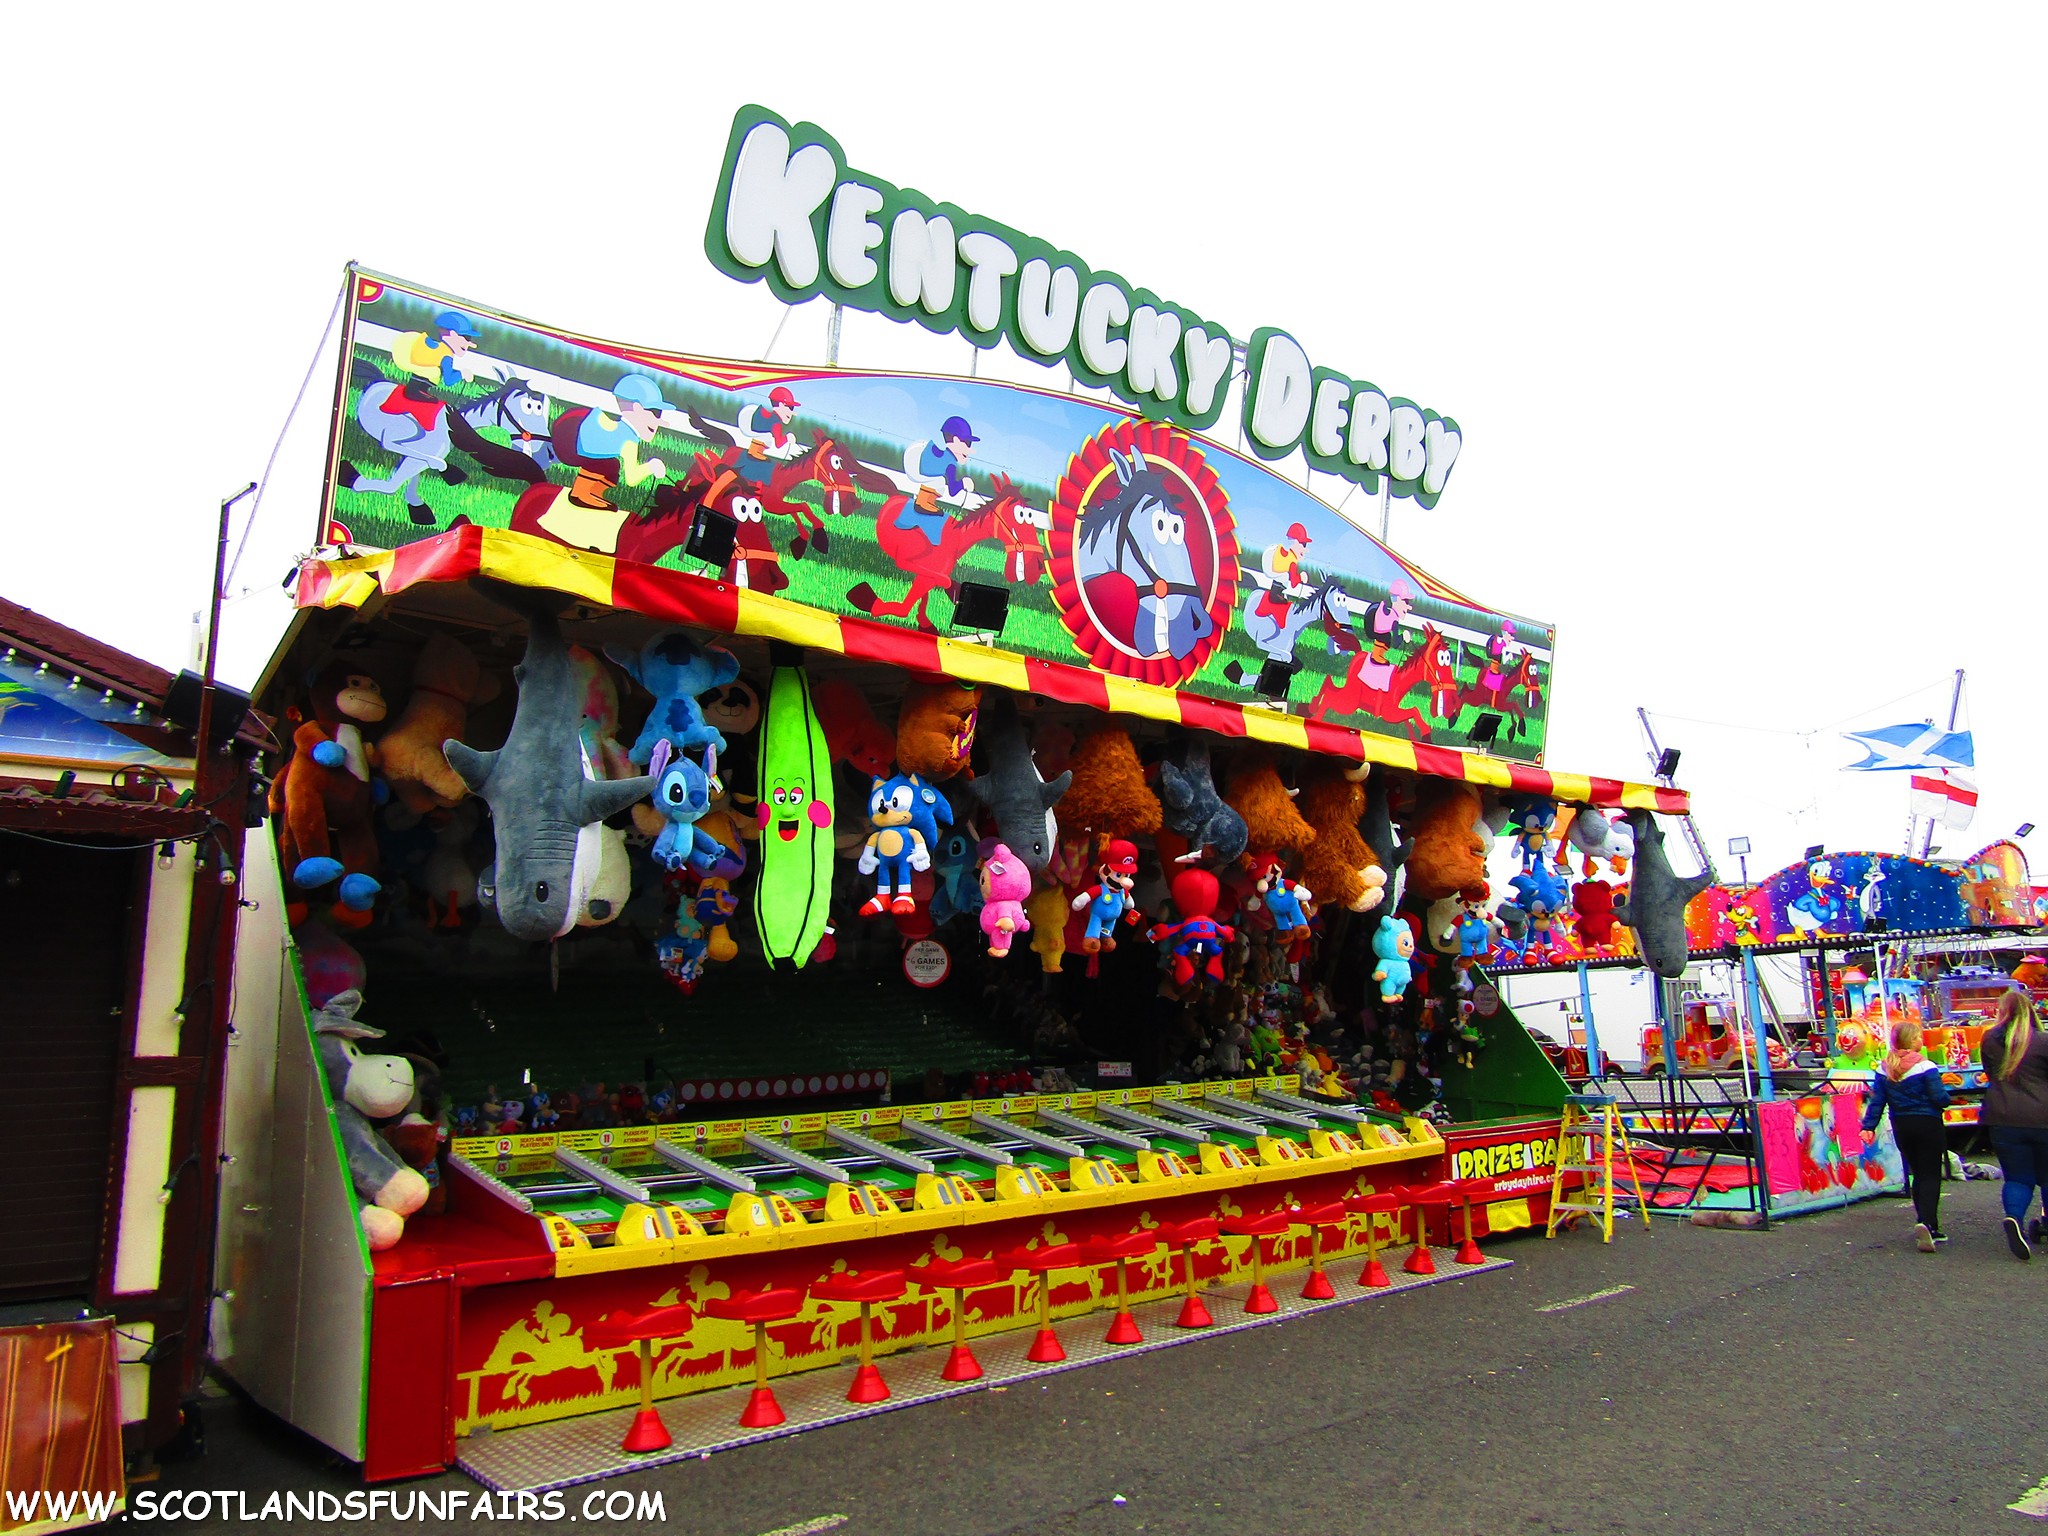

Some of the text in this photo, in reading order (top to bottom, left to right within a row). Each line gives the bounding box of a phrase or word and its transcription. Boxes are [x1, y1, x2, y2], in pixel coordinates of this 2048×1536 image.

[726, 121, 1462, 495] KENTUCKY DERBY
[917, 957, 945, 965] GAMES
[1814, 1042, 1822, 1053] 3
[783, 1120, 789, 1128] 9
[696, 1127, 705, 1136] 10
[603, 1134, 610, 1143] 11
[500, 1141, 509, 1151] 12
[1457, 1142, 1524, 1180] PRIZE
[1493, 1173, 1555, 1192] erbydayhire.co
